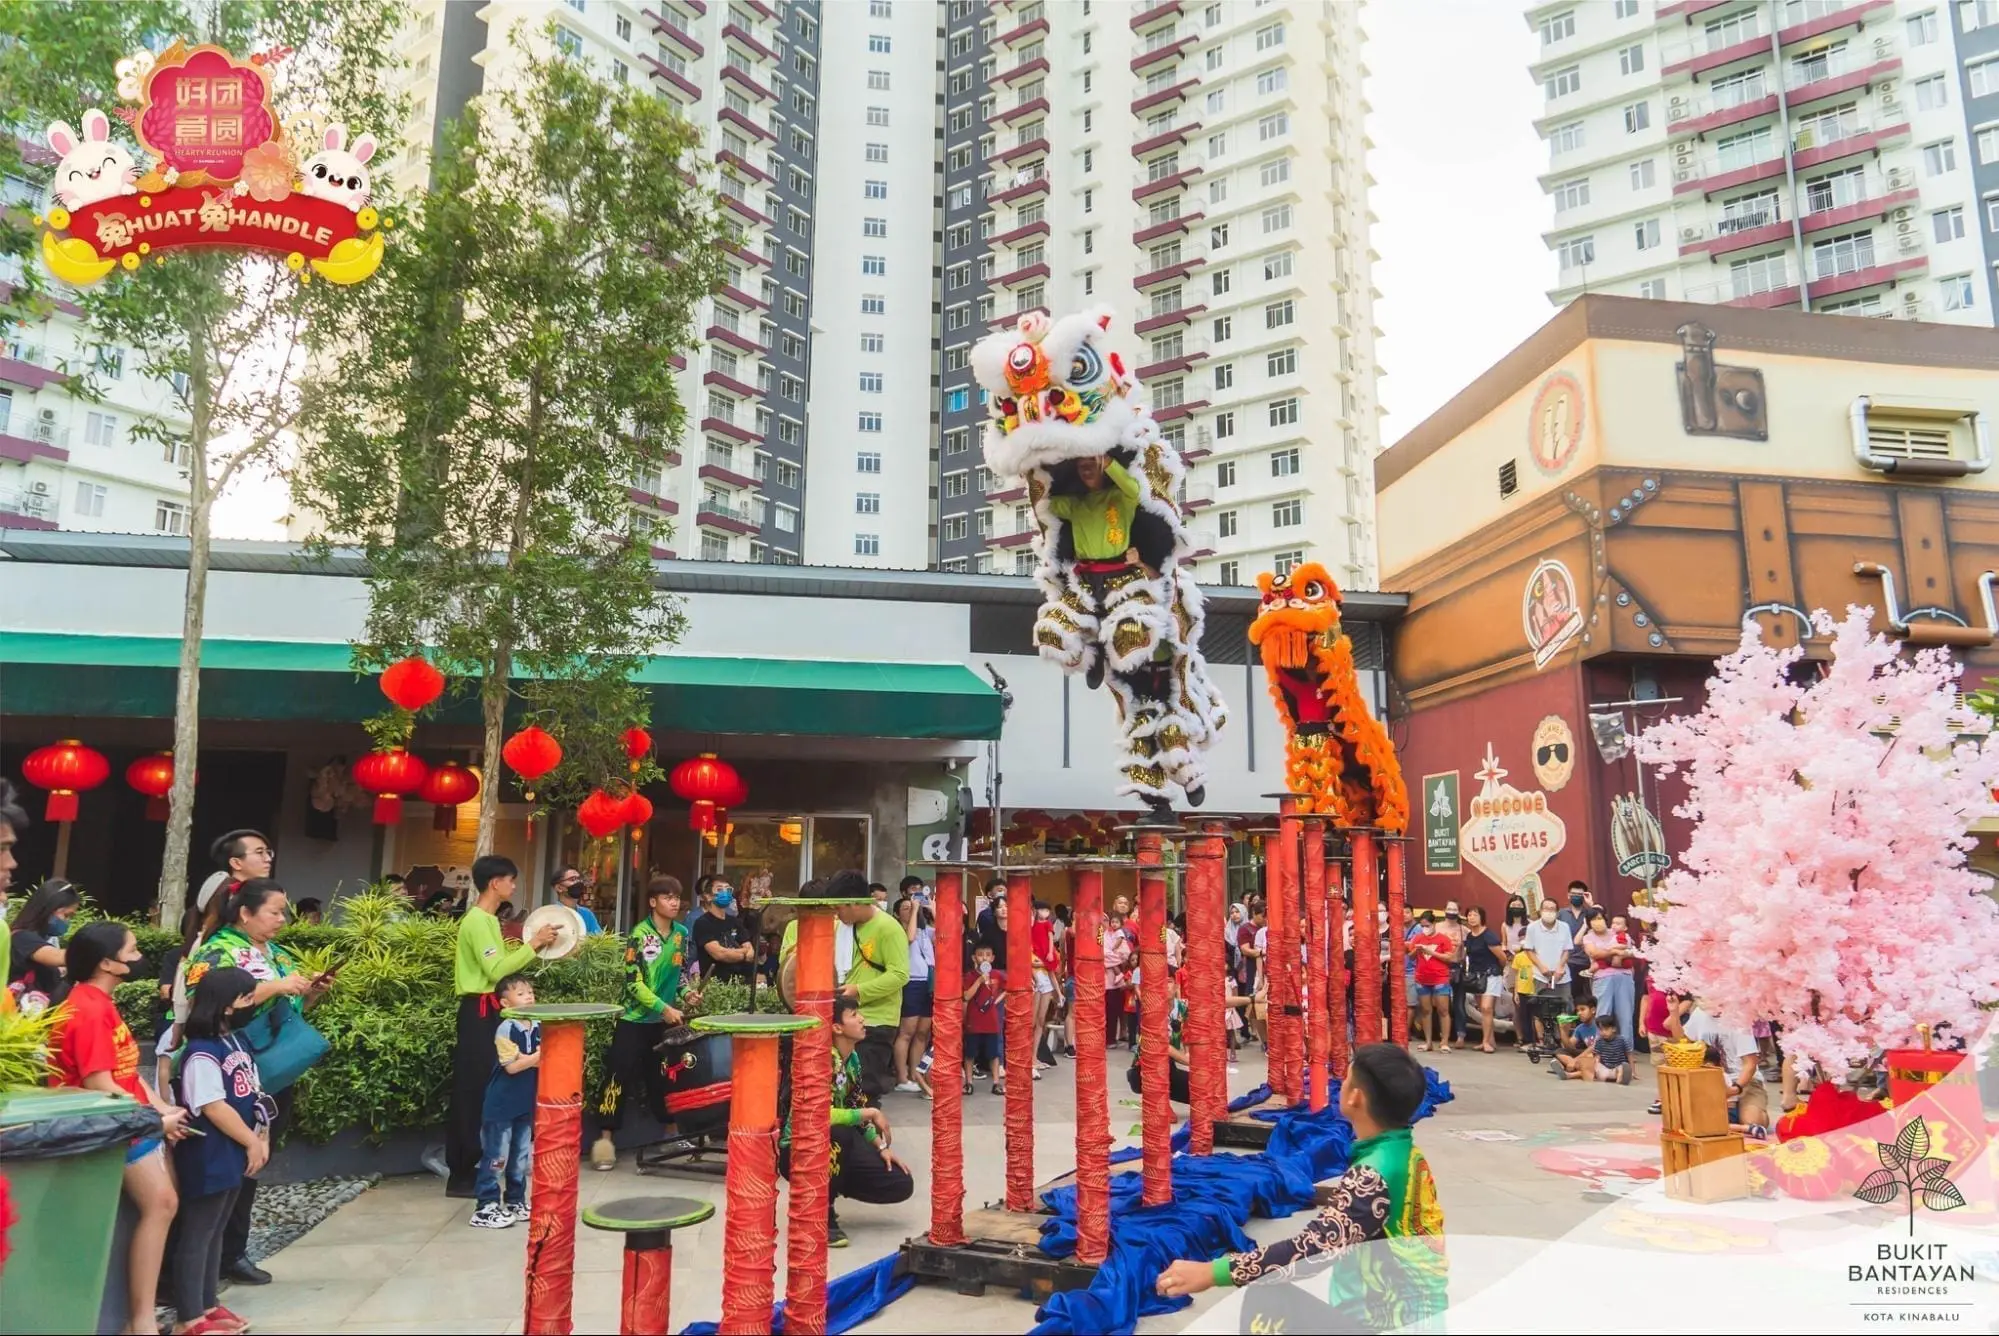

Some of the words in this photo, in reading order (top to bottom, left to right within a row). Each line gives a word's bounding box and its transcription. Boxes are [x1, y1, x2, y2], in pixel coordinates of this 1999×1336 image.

[1473, 797, 1544, 816] WELCOME
[1472, 836, 1497, 853] LAS
[1503, 831, 1548, 850] VEGAS
